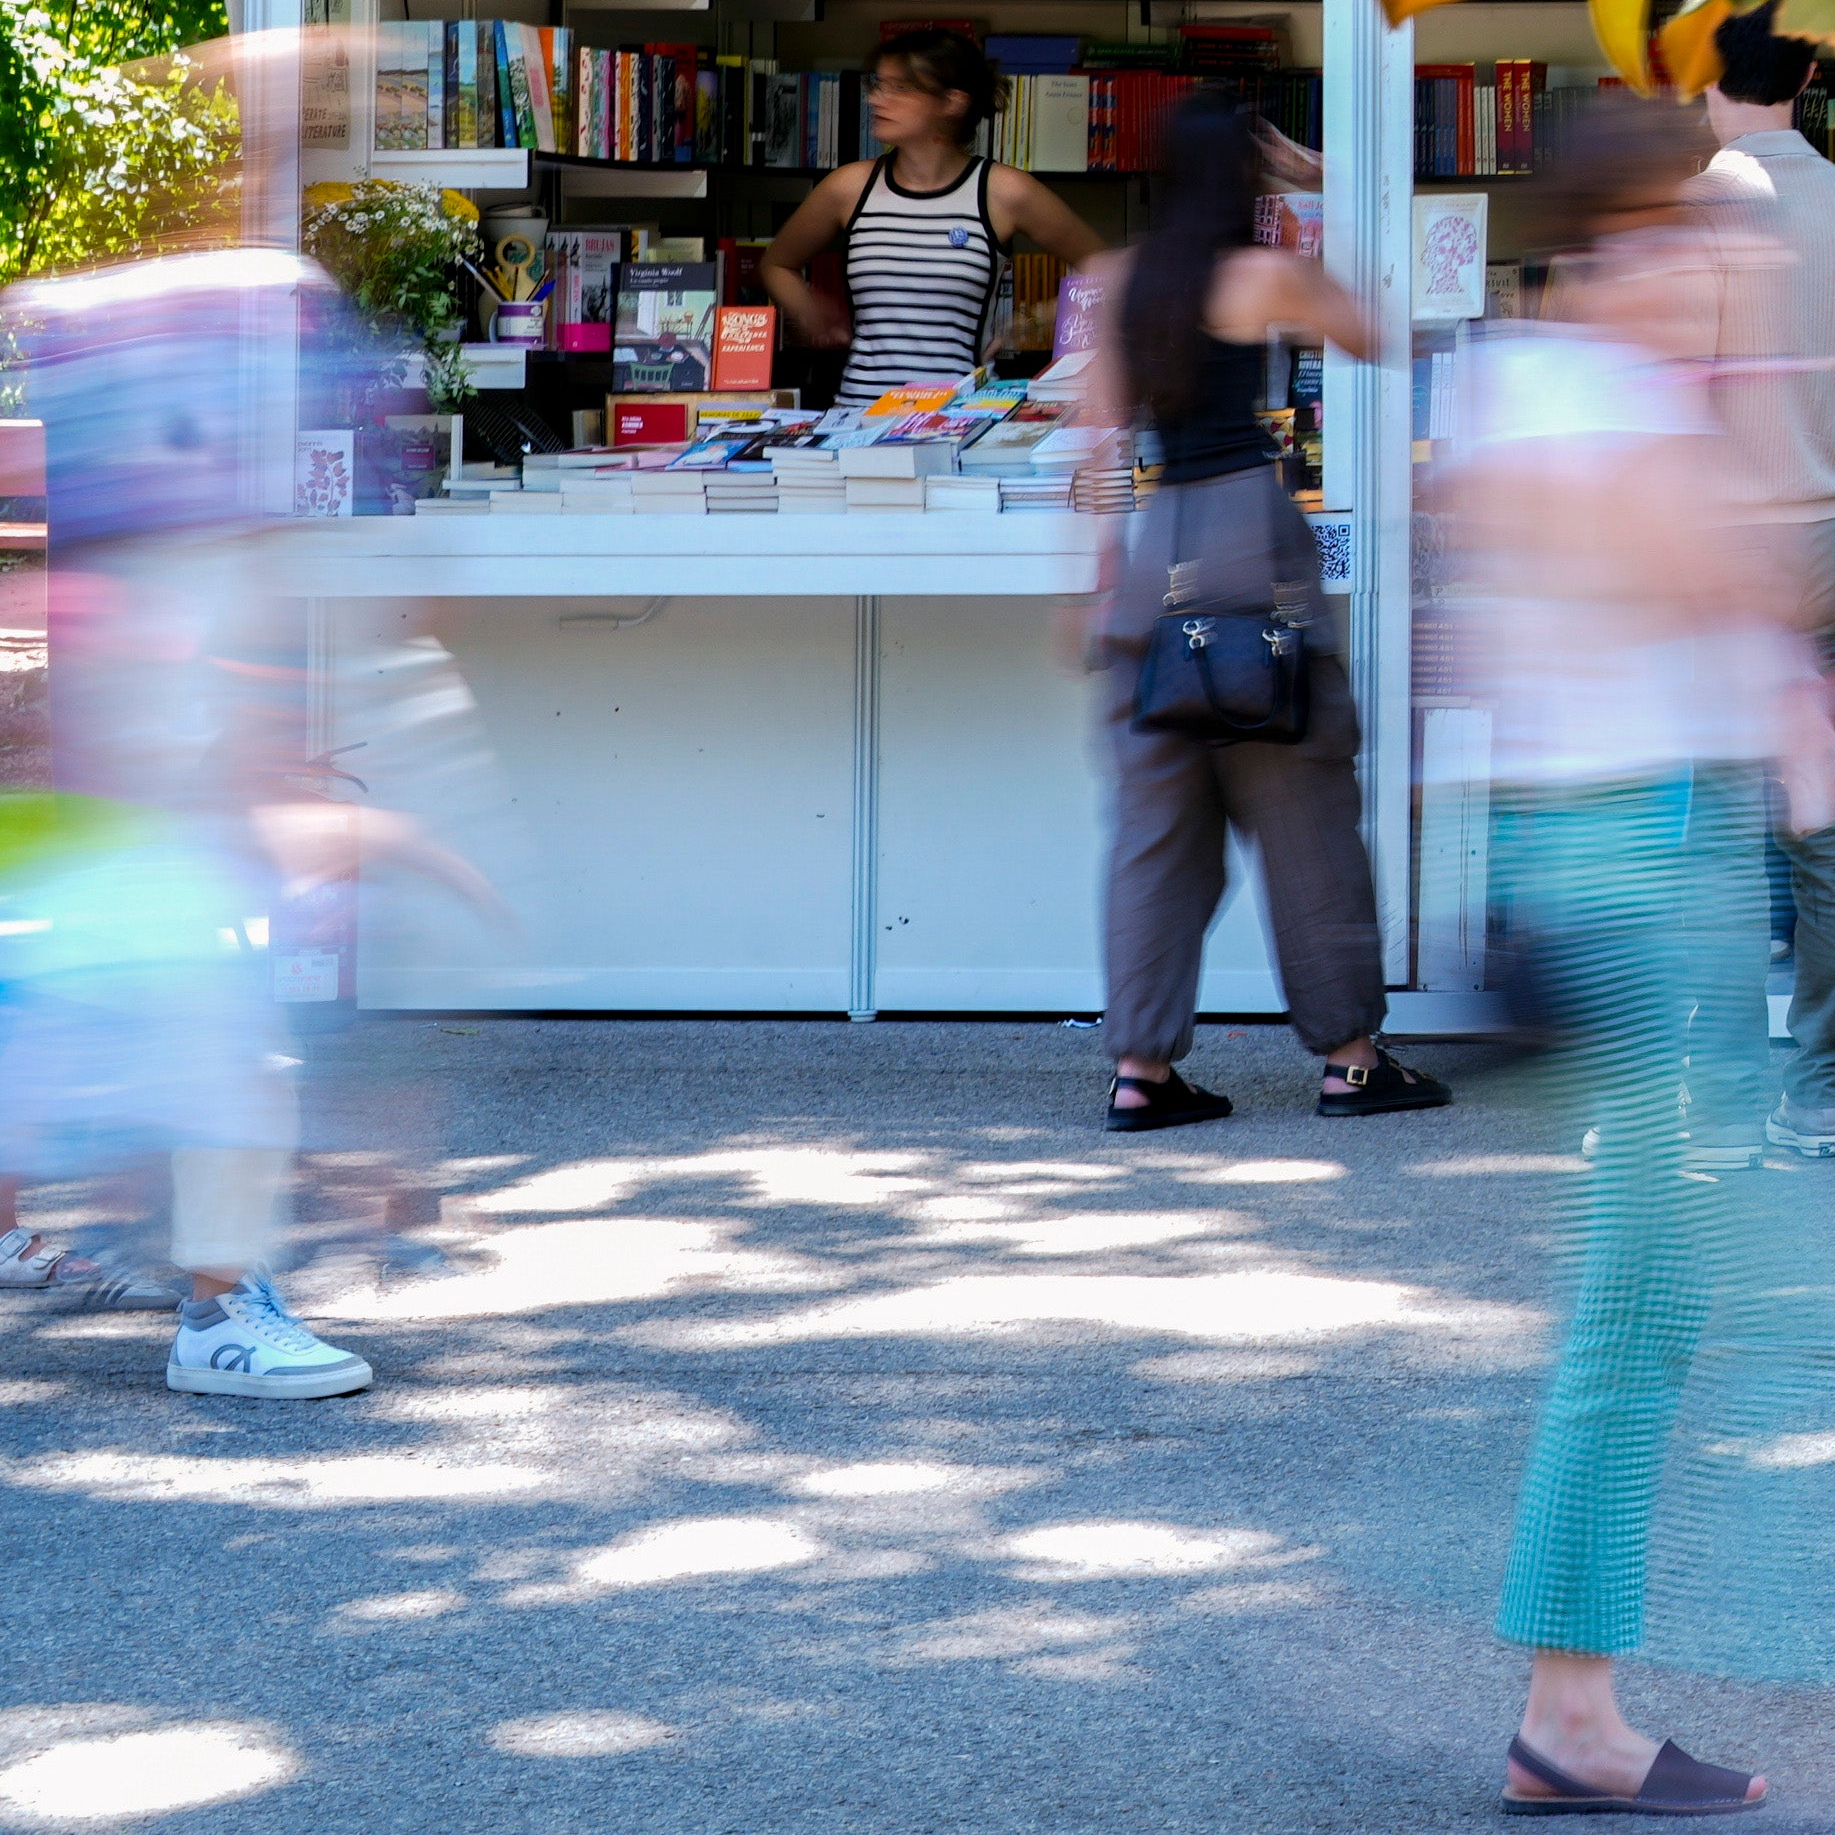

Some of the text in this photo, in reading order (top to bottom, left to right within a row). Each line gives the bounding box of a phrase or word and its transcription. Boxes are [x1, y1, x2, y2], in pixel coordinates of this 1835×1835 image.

[1503, 93, 1513, 132] WOMEN
[1521, 92, 1531, 132] WOMEN
[303, 123, 346, 140] ITERATURE
[585, 238, 615, 252] BRUJAS
[629, 267, 661, 279] Virginia
